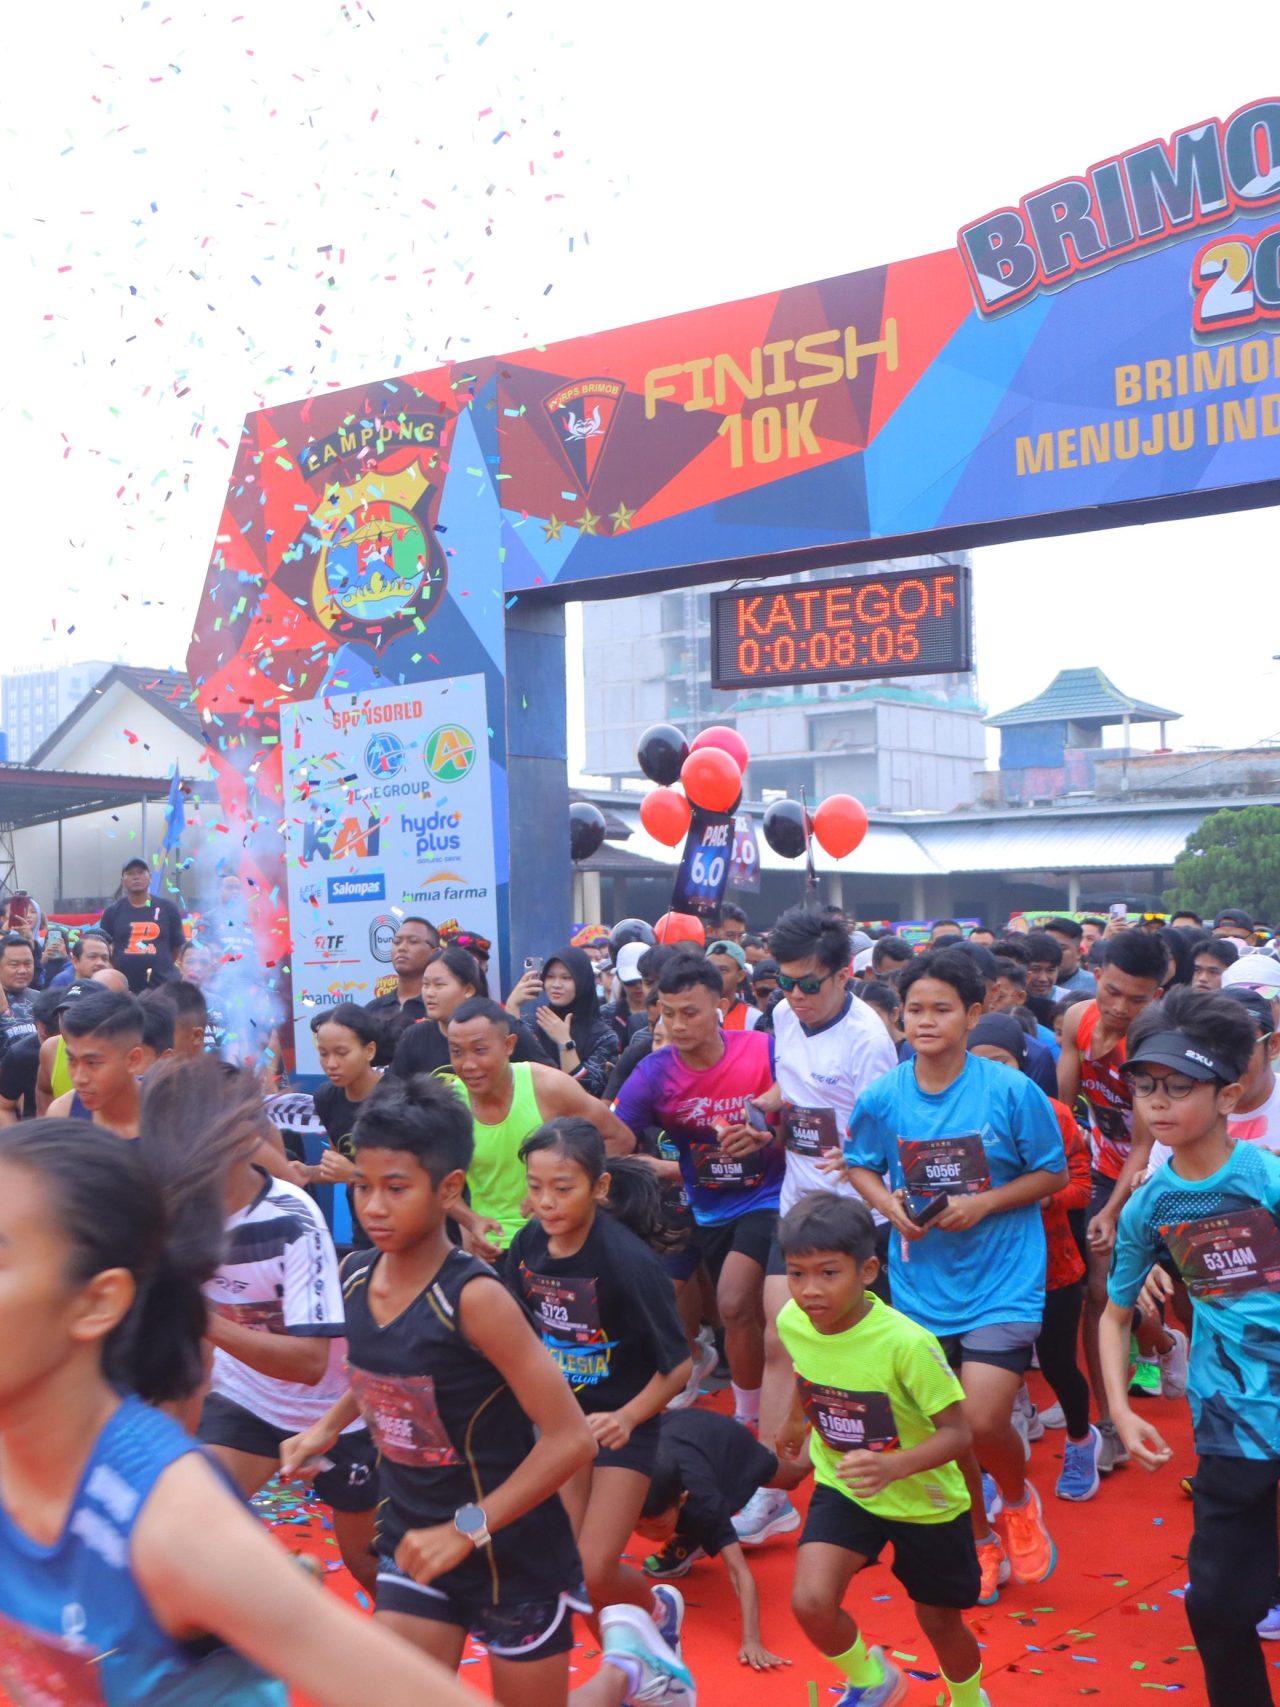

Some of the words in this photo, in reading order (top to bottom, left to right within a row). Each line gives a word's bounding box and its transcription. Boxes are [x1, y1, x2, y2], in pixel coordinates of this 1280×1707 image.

[644, 317, 899, 420] FINISH
[1114, 336, 1280, 406] BRIMO
[582, 384, 619, 395] BRIMOB
[717, 398, 822, 469] 10K
[1015, 408, 1194, 476] MENUJU
[307, 421, 436, 472] LAMPUNG
[736, 623, 920, 675] 0:0:08:05
[383, 781, 429, 798] GROUP
[401, 810, 462, 837] hydro
[417, 832, 460, 856] plus
[701, 824, 729, 847] PACE
[691, 852, 725, 887] 6.0
[332, 881, 380, 896] Salonpas
[444, 887, 487, 900] farma
[302, 990, 354, 1006] mandiri
[1185, 1049, 1214, 1068] 2XU
[793, 1126, 820, 1142] 5444M
[711, 1163, 743, 1175] 5015M
[925, 1163, 961, 1179] 5056F
[1202, 1246, 1257, 1271] 5314M
[540, 1302, 569, 1322] 5723
[817, 1410, 866, 1434] 5160M
